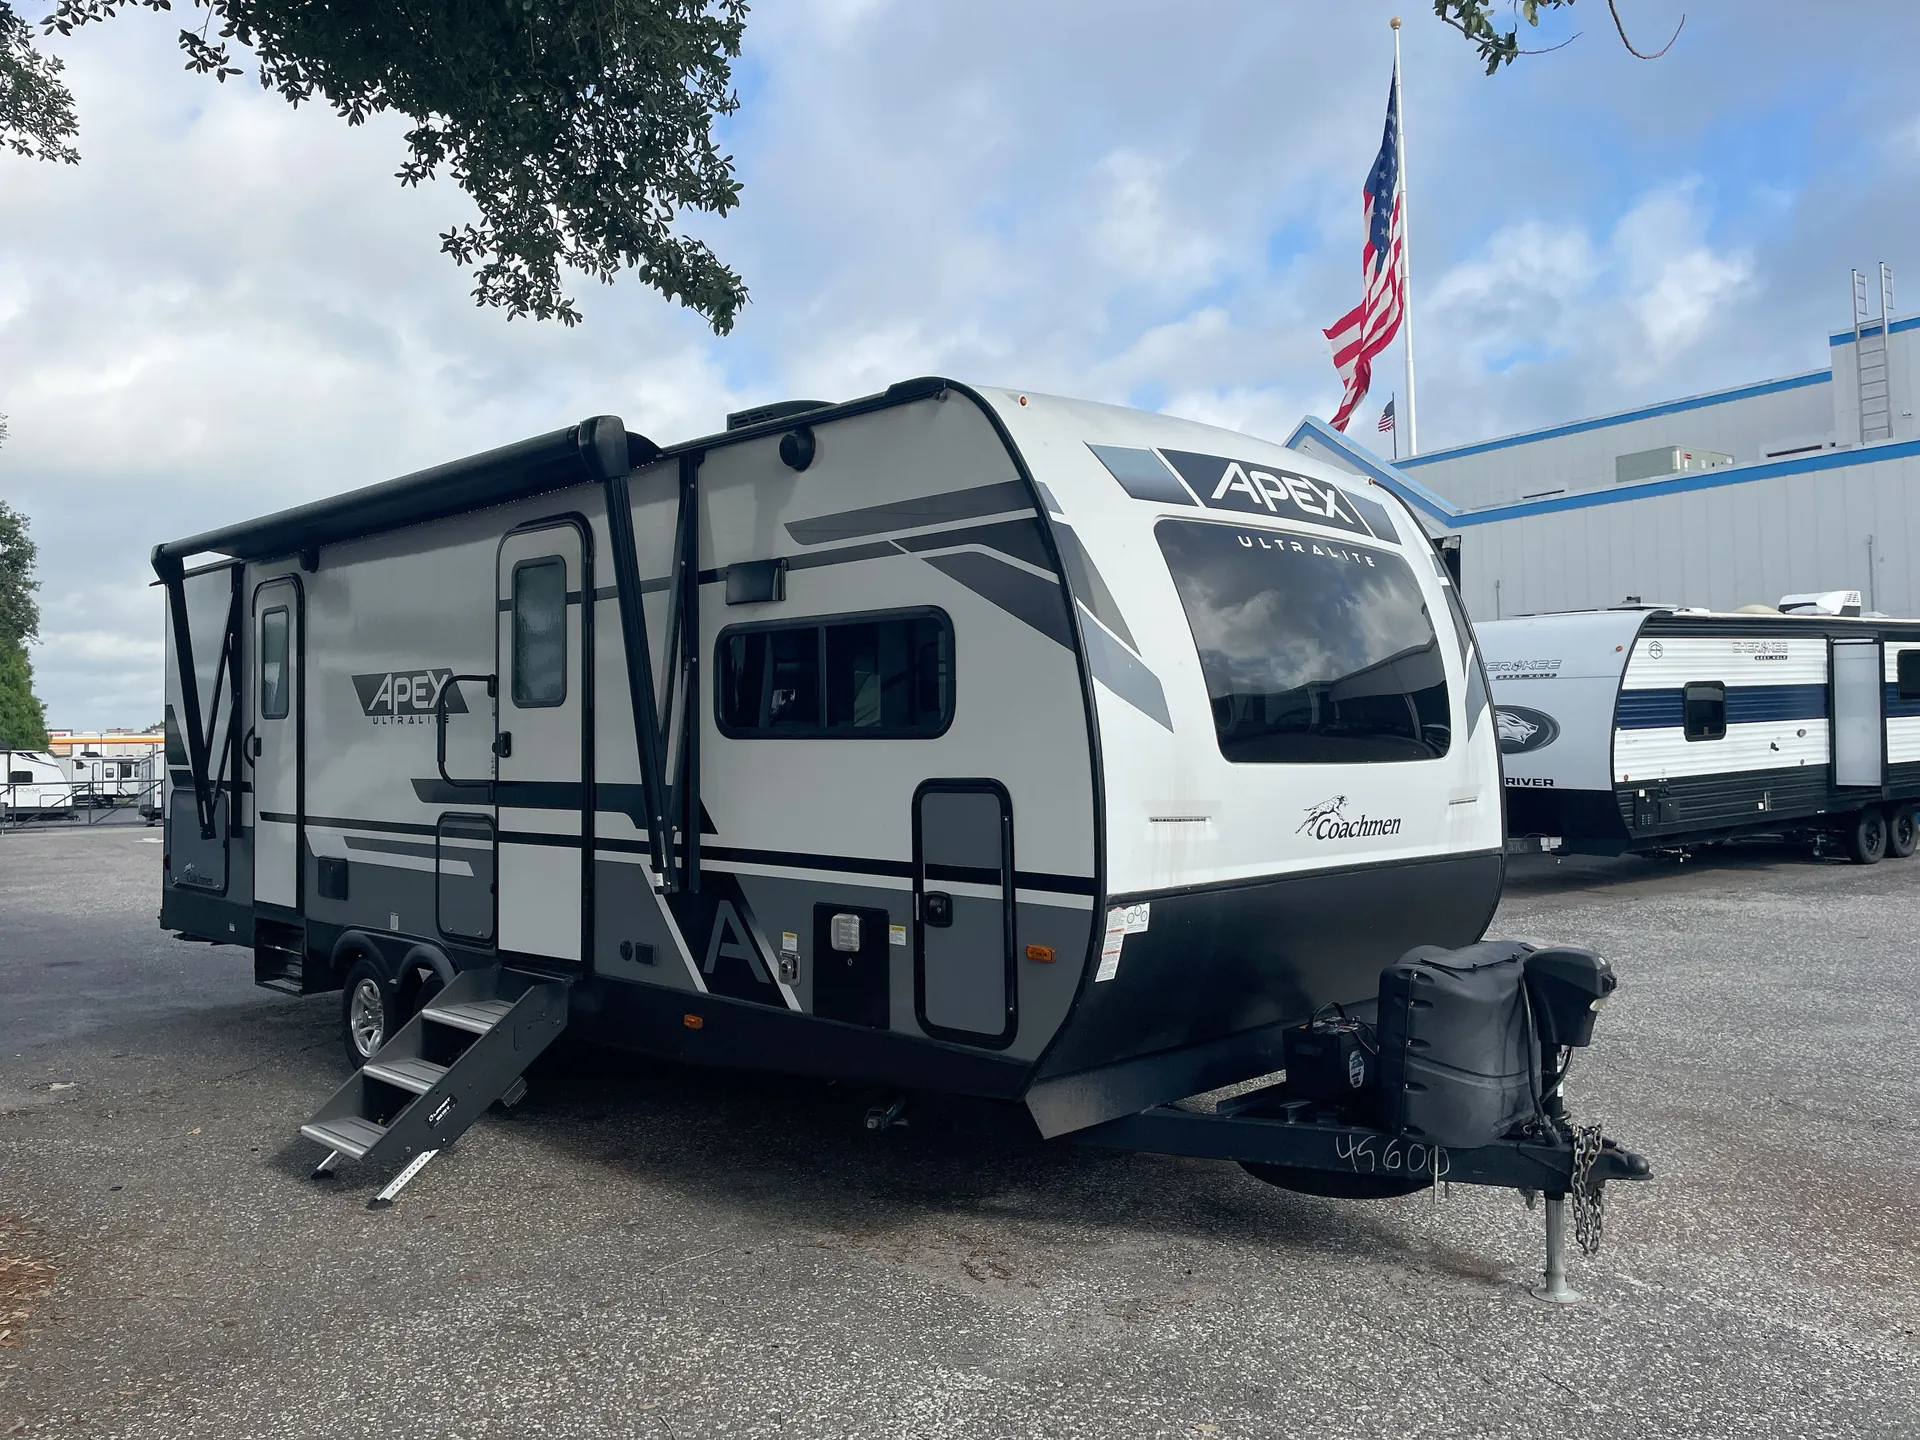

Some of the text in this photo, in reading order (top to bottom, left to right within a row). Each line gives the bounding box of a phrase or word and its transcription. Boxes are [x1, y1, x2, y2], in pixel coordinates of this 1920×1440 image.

[1211, 461, 1354, 524] APEX
[1237, 535, 1375, 567] ULTRALITE
[367, 670, 449, 715] APEX
[1505, 777, 1555, 787] RIVER
[1316, 814, 1402, 840] Coachmen
[1335, 1134, 1450, 1176] 45600
